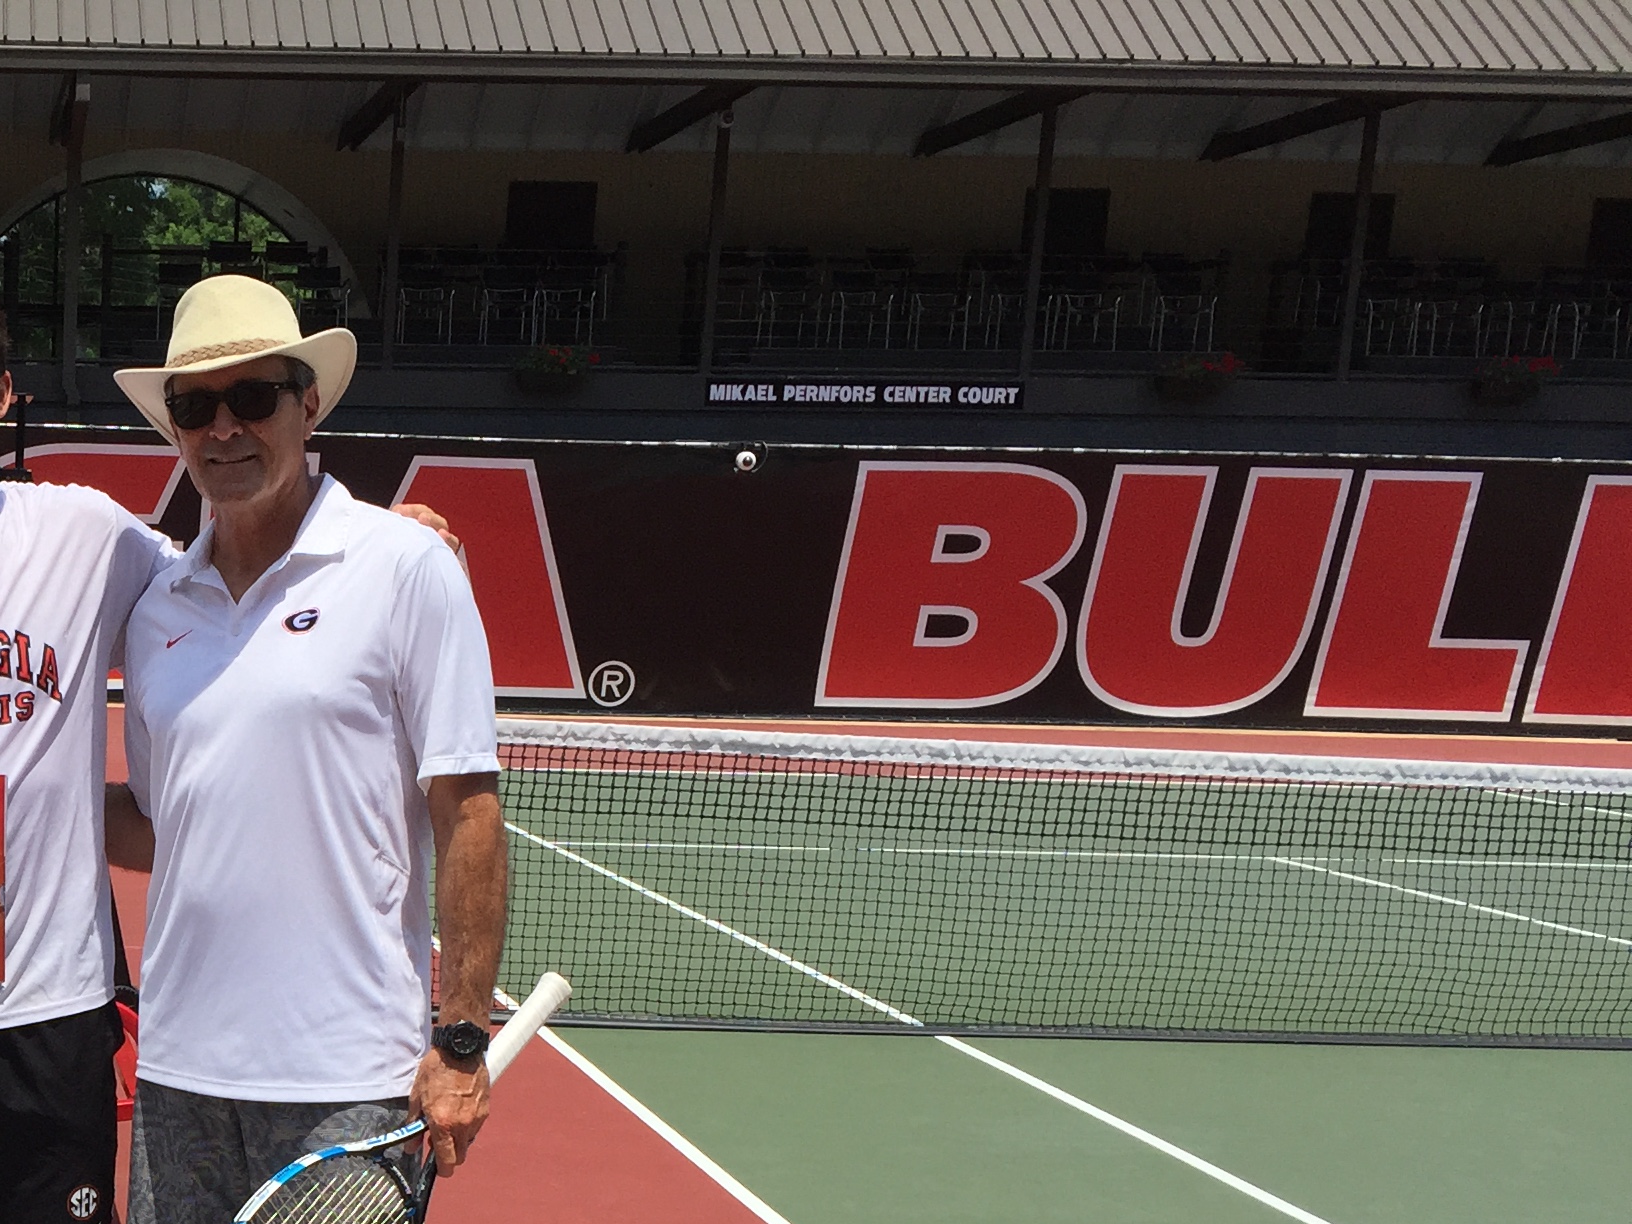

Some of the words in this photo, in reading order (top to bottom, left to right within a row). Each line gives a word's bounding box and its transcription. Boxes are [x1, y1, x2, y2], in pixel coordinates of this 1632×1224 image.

[710, 384, 777, 401] MIKAEL
[783, 385, 876, 402] PERNFORS
[883, 386, 951, 403] CENTER
[958, 387, 1019, 404] COURT
[70, 1186, 98, 1218] SEC
